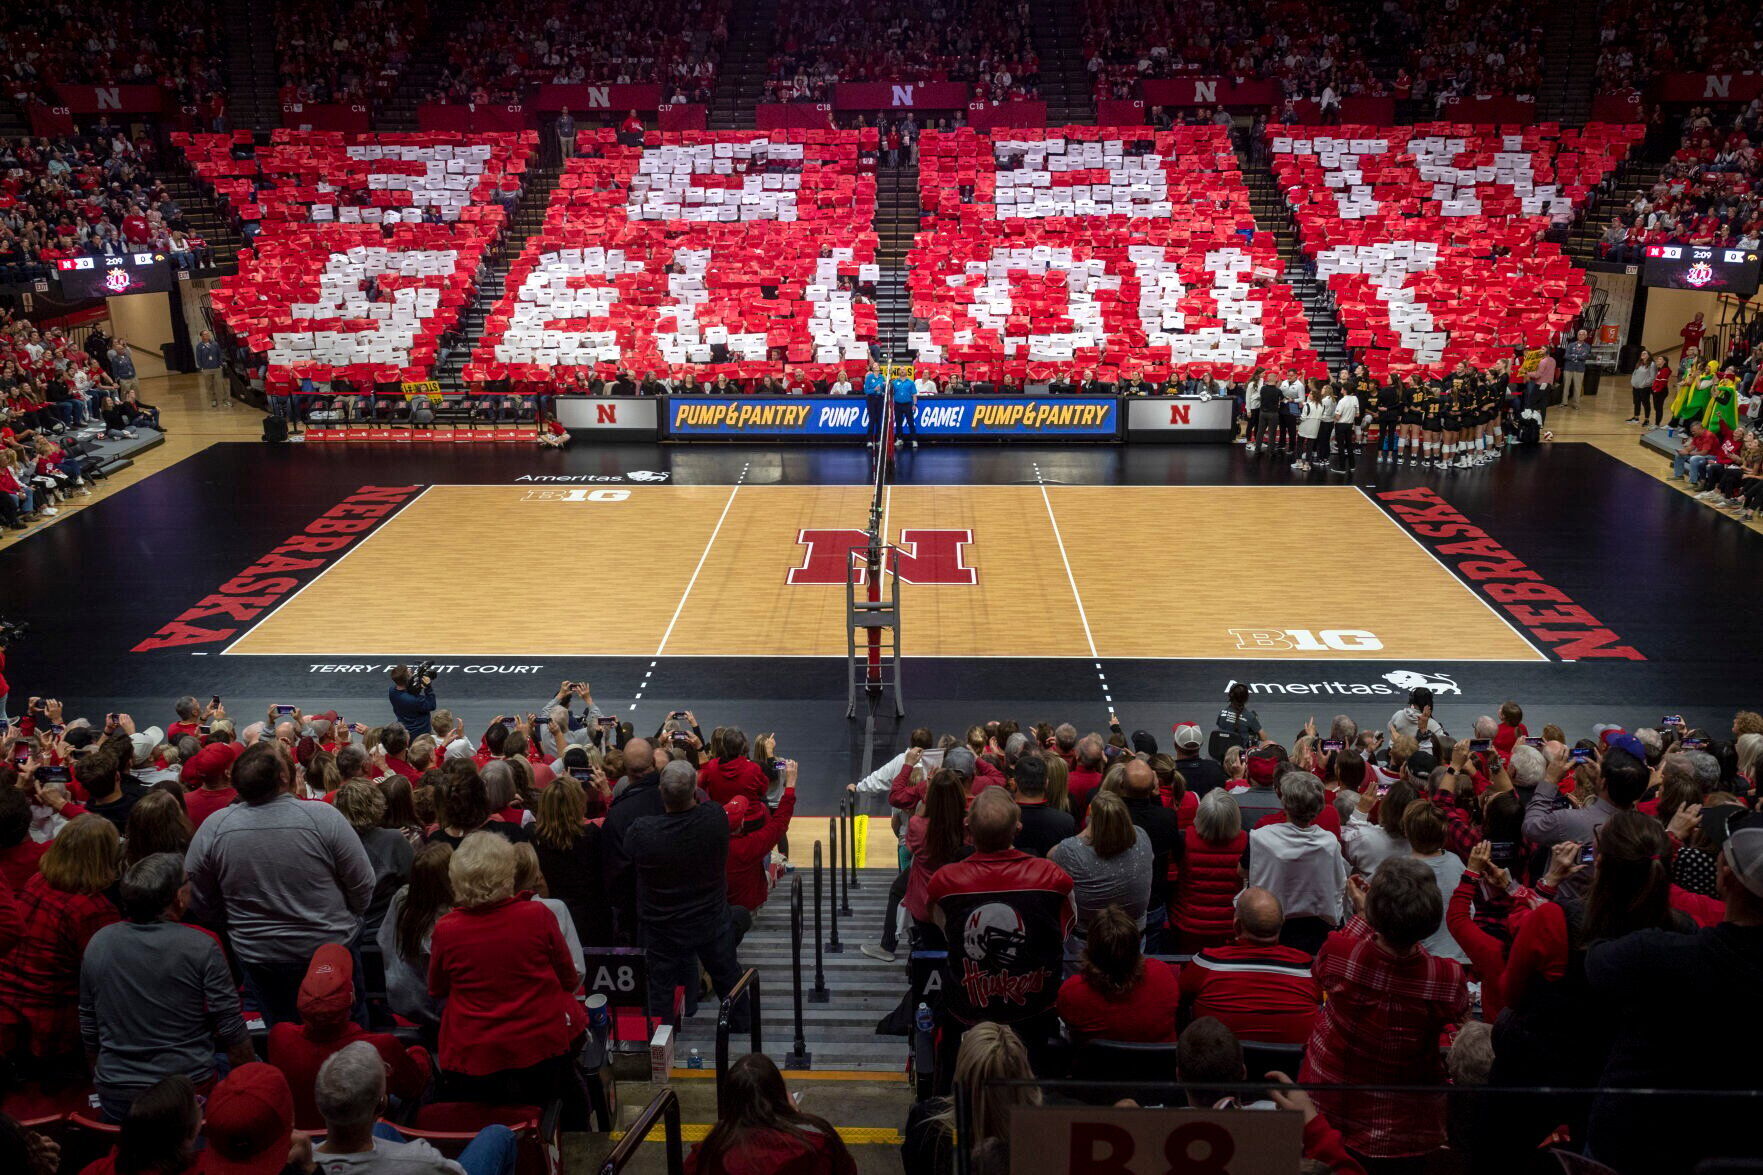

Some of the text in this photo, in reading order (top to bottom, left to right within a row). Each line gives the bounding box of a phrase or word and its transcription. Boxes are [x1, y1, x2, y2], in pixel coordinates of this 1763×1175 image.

[891, 85, 914, 106] N
[1194, 81, 1217, 102] N
[1703, 75, 1732, 98] N
[94, 87, 122, 109] N
[587, 86, 611, 108] N
[816, 103, 831, 111] C18
[969, 102, 984, 111] C18
[1133, 100, 1144, 109] C1
[52, 106, 70, 115] C15
[351, 105, 366, 113] C16
[507, 105, 522, 113] C17
[658, 104, 673, 112] C17
[62, 260, 72, 269] N
[106, 257, 123, 266] 2:09
[1650, 247, 1737, 261] N 0 2:09 0
[597, 404, 616, 423] N
[675, 402, 810, 427] PUMP&PANTRY
[819, 407, 860, 427] PUMP
[920, 406, 965, 428] GAME!
[971, 402, 1108, 427] PUMP&PANTRY
[1170, 404, 1190, 425] N
[515, 474, 623, 482] Ameritas
[785, 529, 979, 585] N
[130, 485, 420, 652] NEBRASKA
[1376, 486, 1648, 661] NEBRASKA
[309, 664, 381, 673] TERRY
[463, 664, 543, 674] COURT
[969, 911, 982, 929] N
[592, 965, 635, 992] A8
